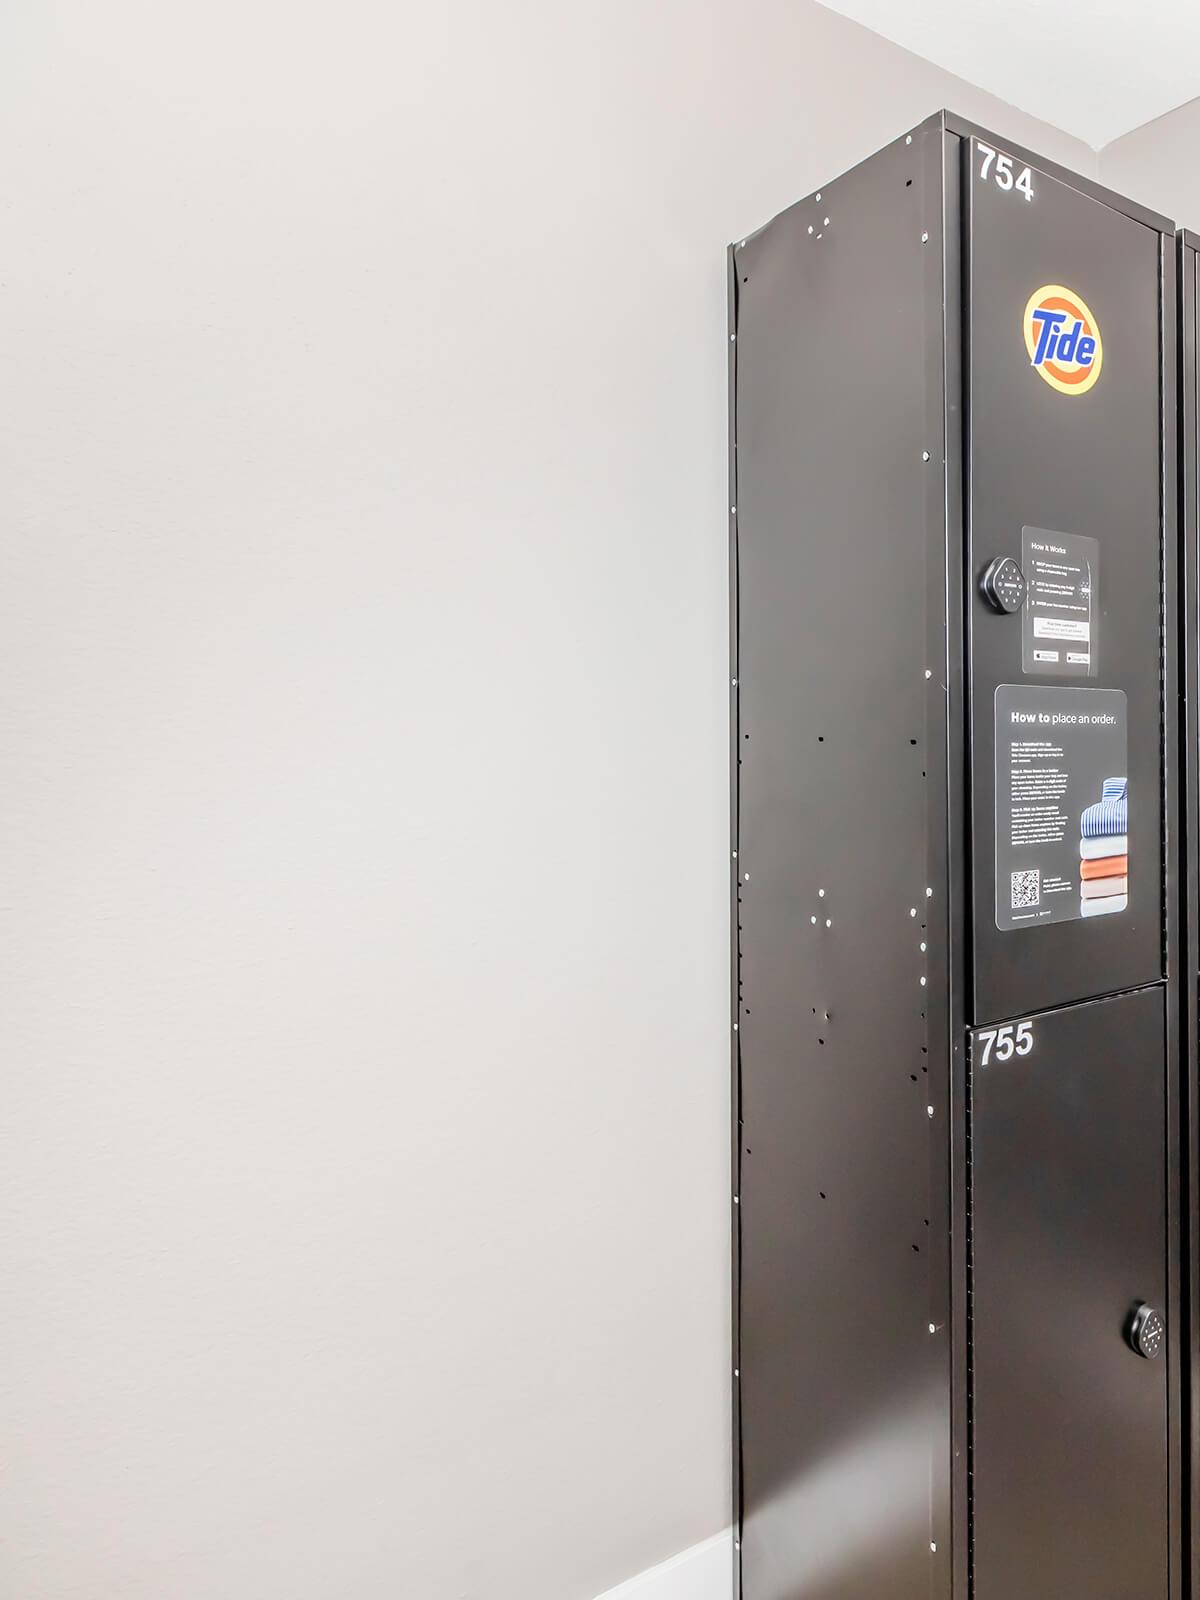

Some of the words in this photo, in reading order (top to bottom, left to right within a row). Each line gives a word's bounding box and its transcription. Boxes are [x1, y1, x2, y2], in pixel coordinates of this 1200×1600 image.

[978, 143, 1034, 201] 754
[1031, 309, 1096, 366] Tide
[1031, 542, 1044, 550] How
[1050, 545, 1067, 554] Works
[1011, 712, 1036, 723] How
[1039, 712, 1050, 723] to
[1052, 713, 1077, 725] place
[1078, 715, 1090, 724] an
[1091, 714, 1117, 725] order.
[978, 1021, 1034, 1066] 755
